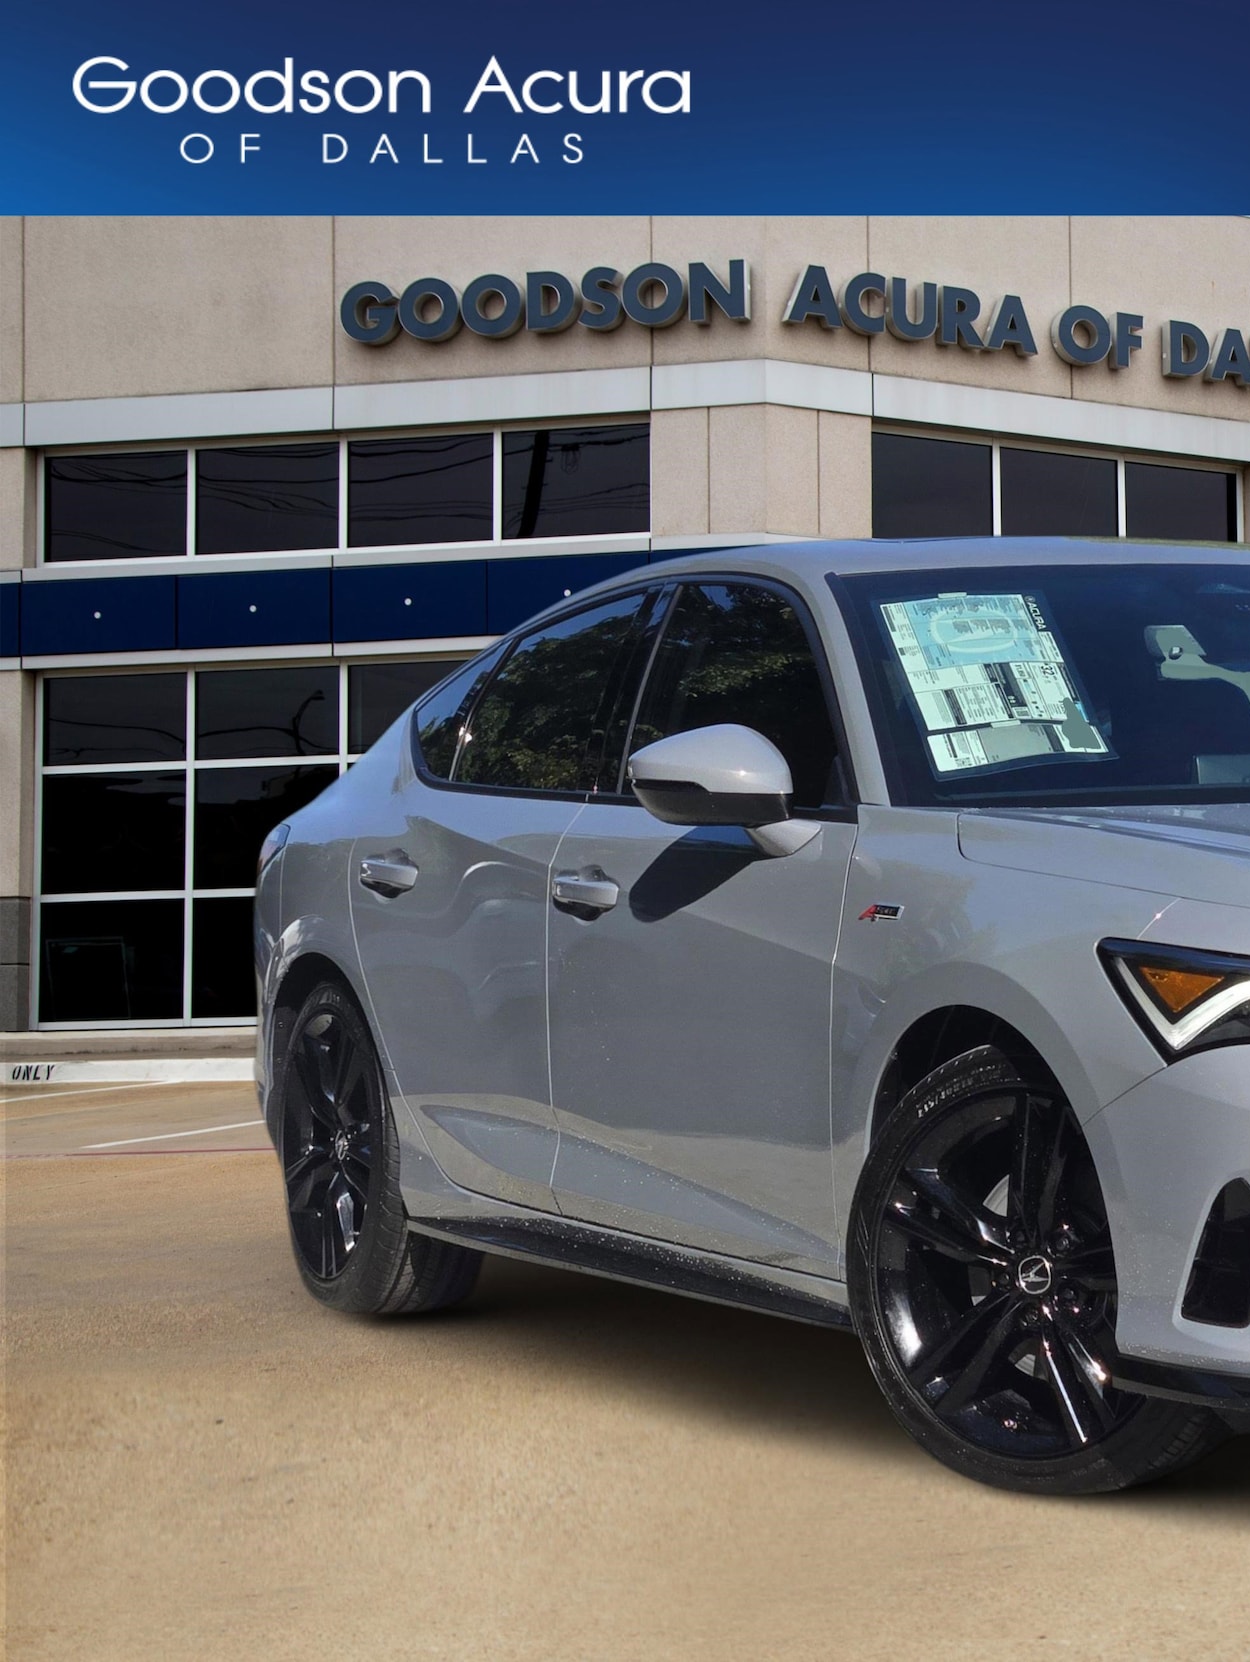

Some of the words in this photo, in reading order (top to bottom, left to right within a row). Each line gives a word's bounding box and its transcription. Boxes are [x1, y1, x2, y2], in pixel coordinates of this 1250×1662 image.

[340, 259, 750, 344] GOODSON
[782, 264, 1038, 357] ACURA
[1051, 304, 1143, 370] OF
[1027, 602, 1047, 629] ACURA
[12, 1064, 55, 1080] ONLY
